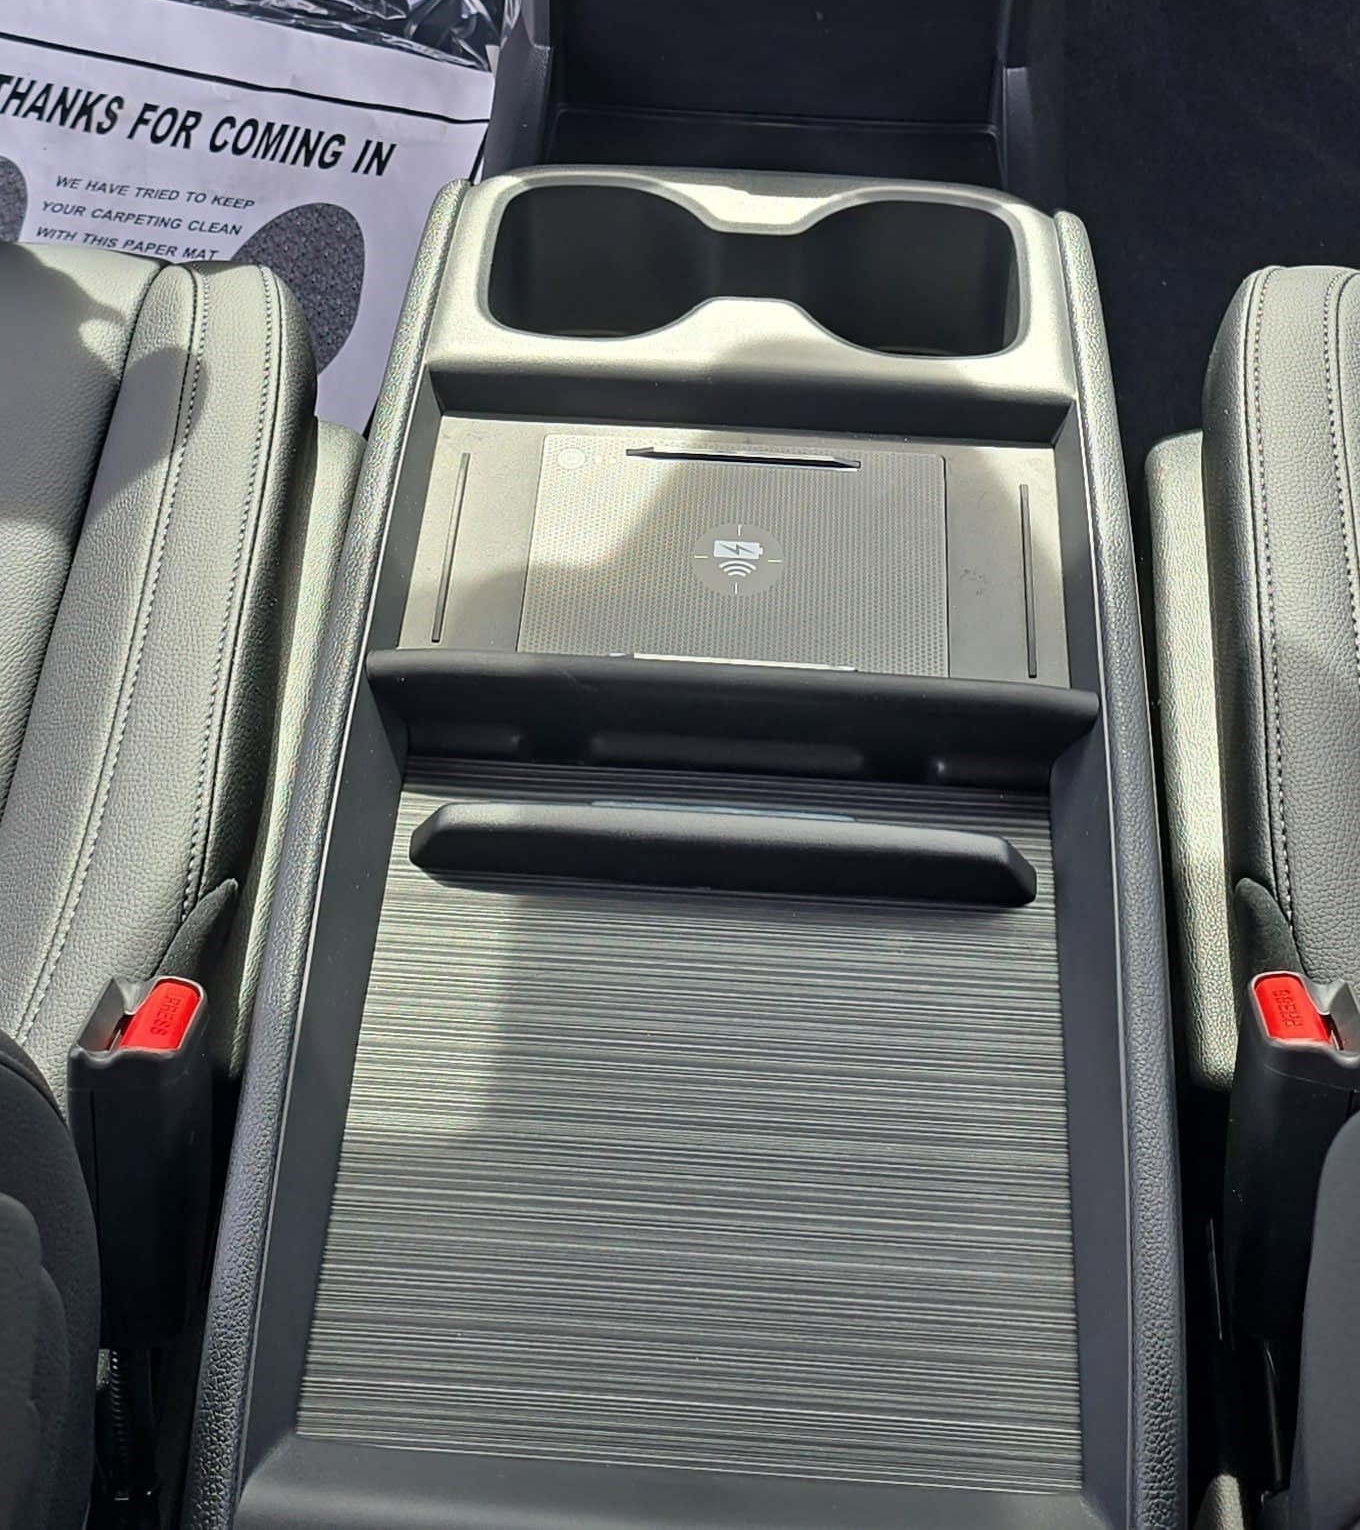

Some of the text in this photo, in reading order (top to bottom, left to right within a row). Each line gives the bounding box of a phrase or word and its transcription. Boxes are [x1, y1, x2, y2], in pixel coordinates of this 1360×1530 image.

[126, 102, 203, 150] FOR
[209, 115, 346, 170] COMING
[351, 139, 397, 177] IN
[56, 175, 255, 211] WE HAVE TRIED TO KEEP
[41, 201, 243, 236] YOUR CARPETING CLEAN
[36, 226, 220, 261] WITH THIS PAPER MAT
[150, 994, 186, 1036] PRESS
